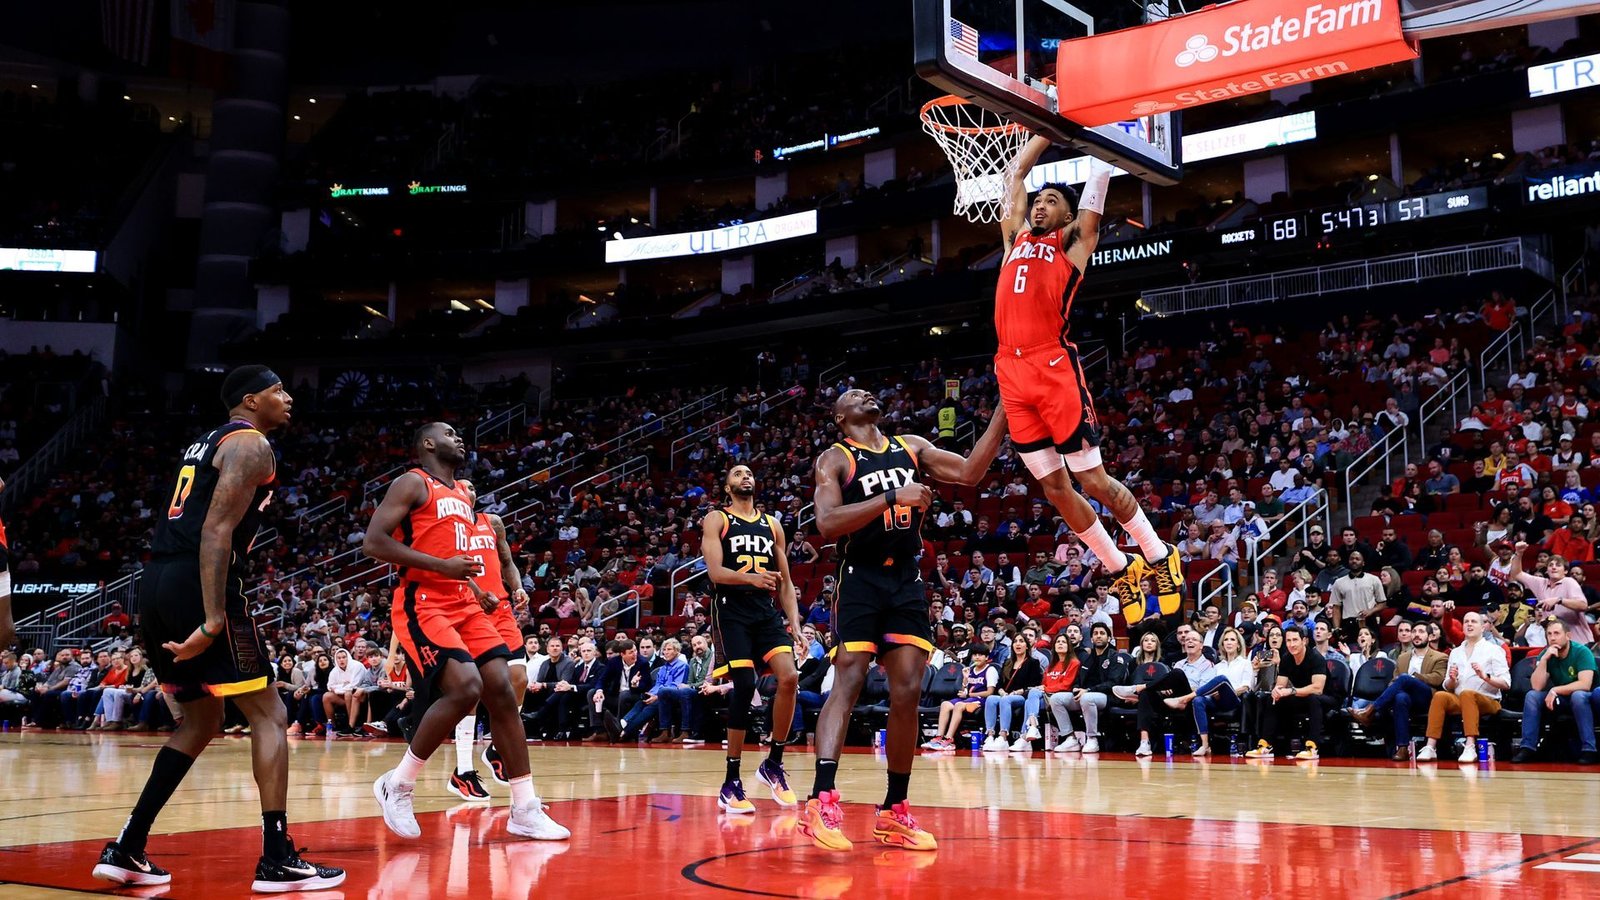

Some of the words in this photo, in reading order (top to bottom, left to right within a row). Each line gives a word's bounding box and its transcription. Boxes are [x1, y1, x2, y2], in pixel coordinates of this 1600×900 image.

[1528, 170, 1600, 202] reliant
[1221, 229, 1255, 245] ROCKETS
[1273, 218, 1297, 241] 68
[1447, 195, 1469, 209] SUNS
[689, 222, 768, 254] ULTRA
[1013, 264, 1028, 294] 6
[168, 465, 196, 520] 0
[858, 467, 915, 497] PHX
[453, 521, 468, 551] 16
[729, 534, 774, 557] PHX
[736, 554, 769, 574] 25
[13, 583, 52, 594] LIGHT
[60, 583, 97, 594] FUSE
